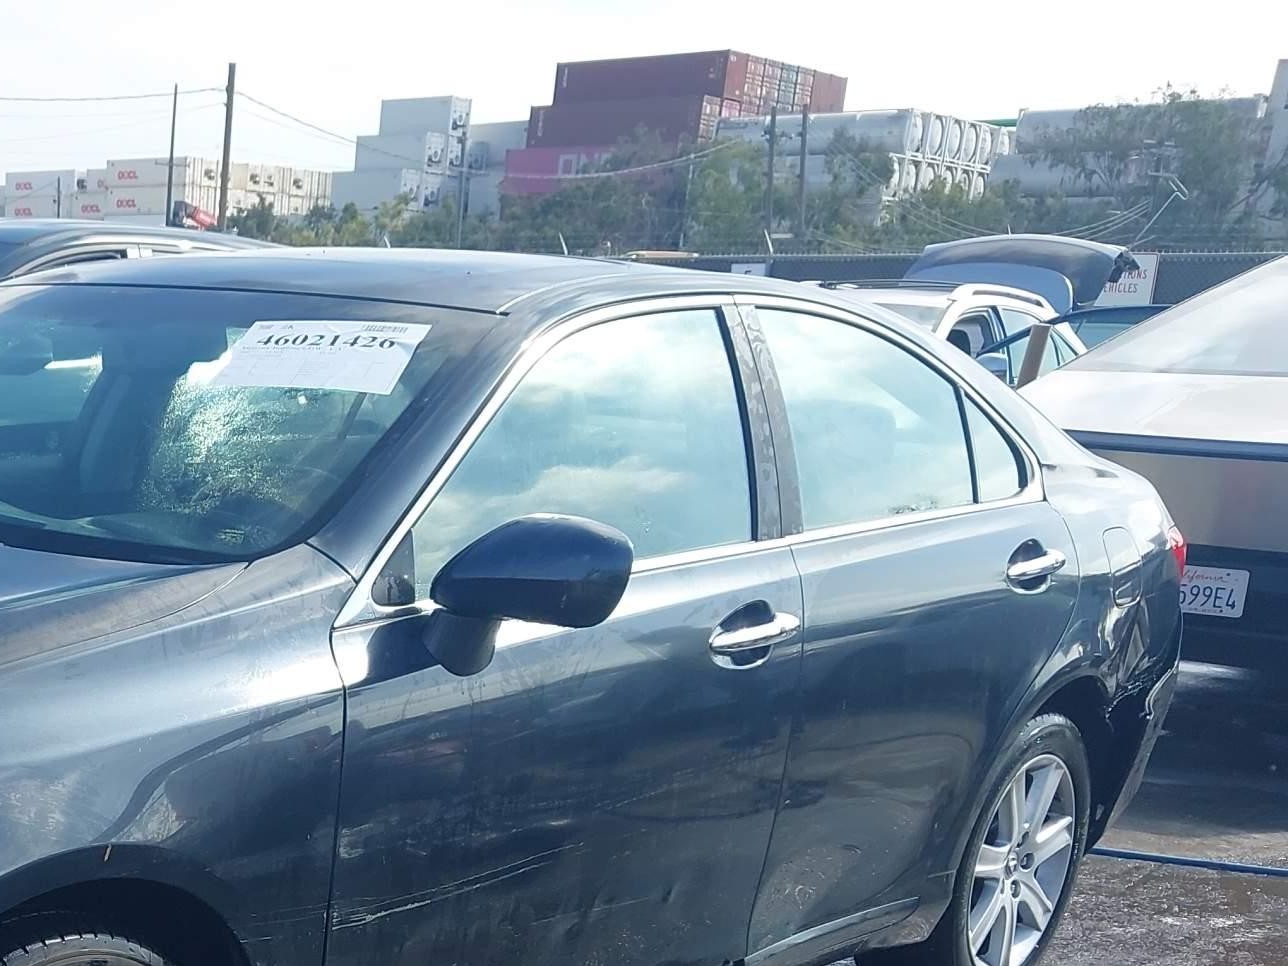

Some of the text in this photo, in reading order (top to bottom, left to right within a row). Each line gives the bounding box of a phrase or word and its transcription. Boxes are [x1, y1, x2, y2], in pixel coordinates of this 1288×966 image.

[1104, 282, 1138, 293] EHICLES
[257, 333, 397, 350] 46021426
[1180, 583, 1236, 610] 599E4
